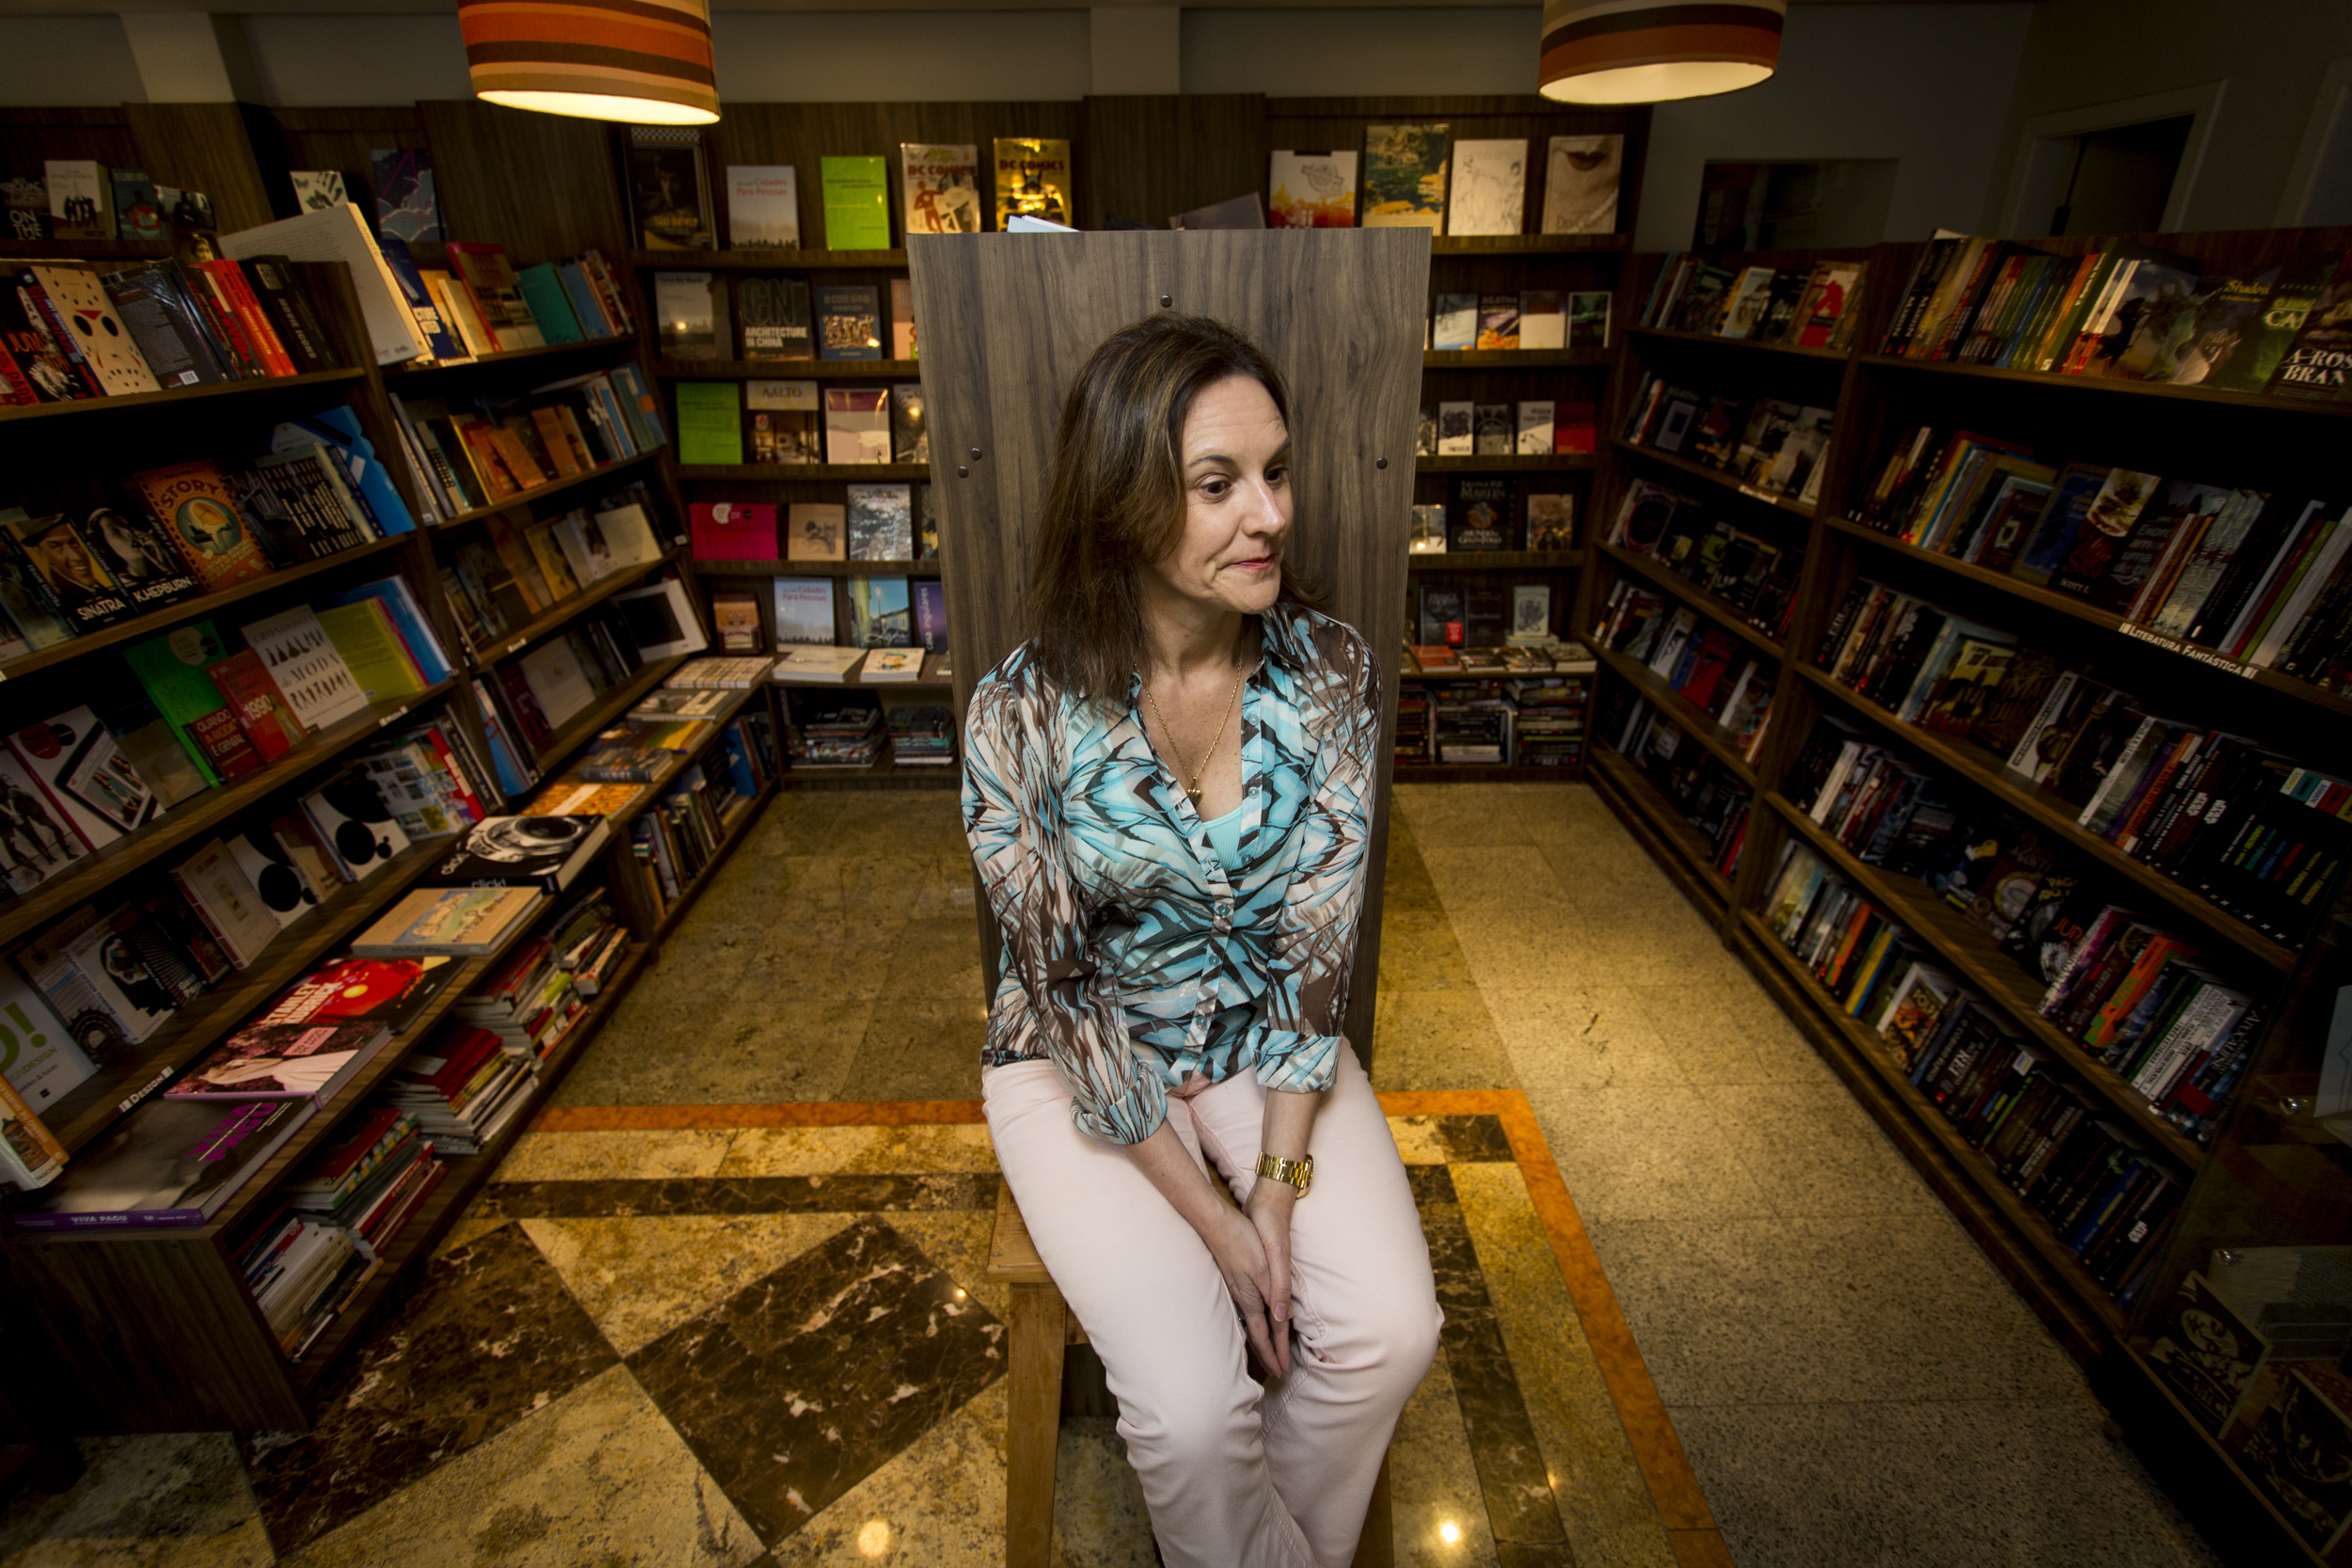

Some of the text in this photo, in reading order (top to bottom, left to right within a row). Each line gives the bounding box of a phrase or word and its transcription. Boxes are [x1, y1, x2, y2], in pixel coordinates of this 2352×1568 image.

[908, 166, 925, 175] DC
[999, 160, 1064, 170] DC COMICS
[9, 209, 38, 224] ON
[13, 223, 42, 237] THE
[254, 306, 270, 327] CHARLES
[267, 330, 284, 353] CHAPLIN
[278, 297, 299, 329] MOVIE
[296, 328, 317, 359] ICONS
[1890, 296, 1916, 336] MARTIN
[1902, 295, 1930, 337] MARTIN
[242, 307, 258, 330] CHARLES
[256, 332, 272, 355] CHAPLIN
[745, 326, 807, 338] ARCHITECTURE
[745, 338, 784, 348] IN CHINA
[7, 372, 37, 404] PARK
[761, 387, 803, 398] AALTO
[160, 478, 219, 509] STORY
[2122, 552, 2153, 562] uma
[26, 563, 60, 607] FRANK SINATRA
[132, 576, 192, 603] K.HEPBURN
[782, 593, 827, 602] Para Pessoas
[798, 586, 827, 594] Cidades
[76, 596, 126, 622] SINATRA
[2129, 626, 2243, 675] LITERATURA FANTÁSTICA
[291, 652, 341, 687] MODA
[243, 694, 272, 721] 1990
[196, 709, 232, 734] QUANDO
[212, 722, 235, 741] MODA
[218, 734, 246, 753] GENIAL
[63, 950, 116, 1015] GRAPHIC DESIGN THINKING
[2112, 976, 2137, 1007] TARZAN
[267, 983, 322, 1024] STANLEY
[284, 984, 335, 1024] KUBRICK
[2211, 1010, 2261, 1072] APOCALIPSE
[128, 1073, 164, 1104] DESIGN
[26, 1118, 48, 1143] DISEÑO
[71, 1214, 128, 1224] VIVA PAGU
